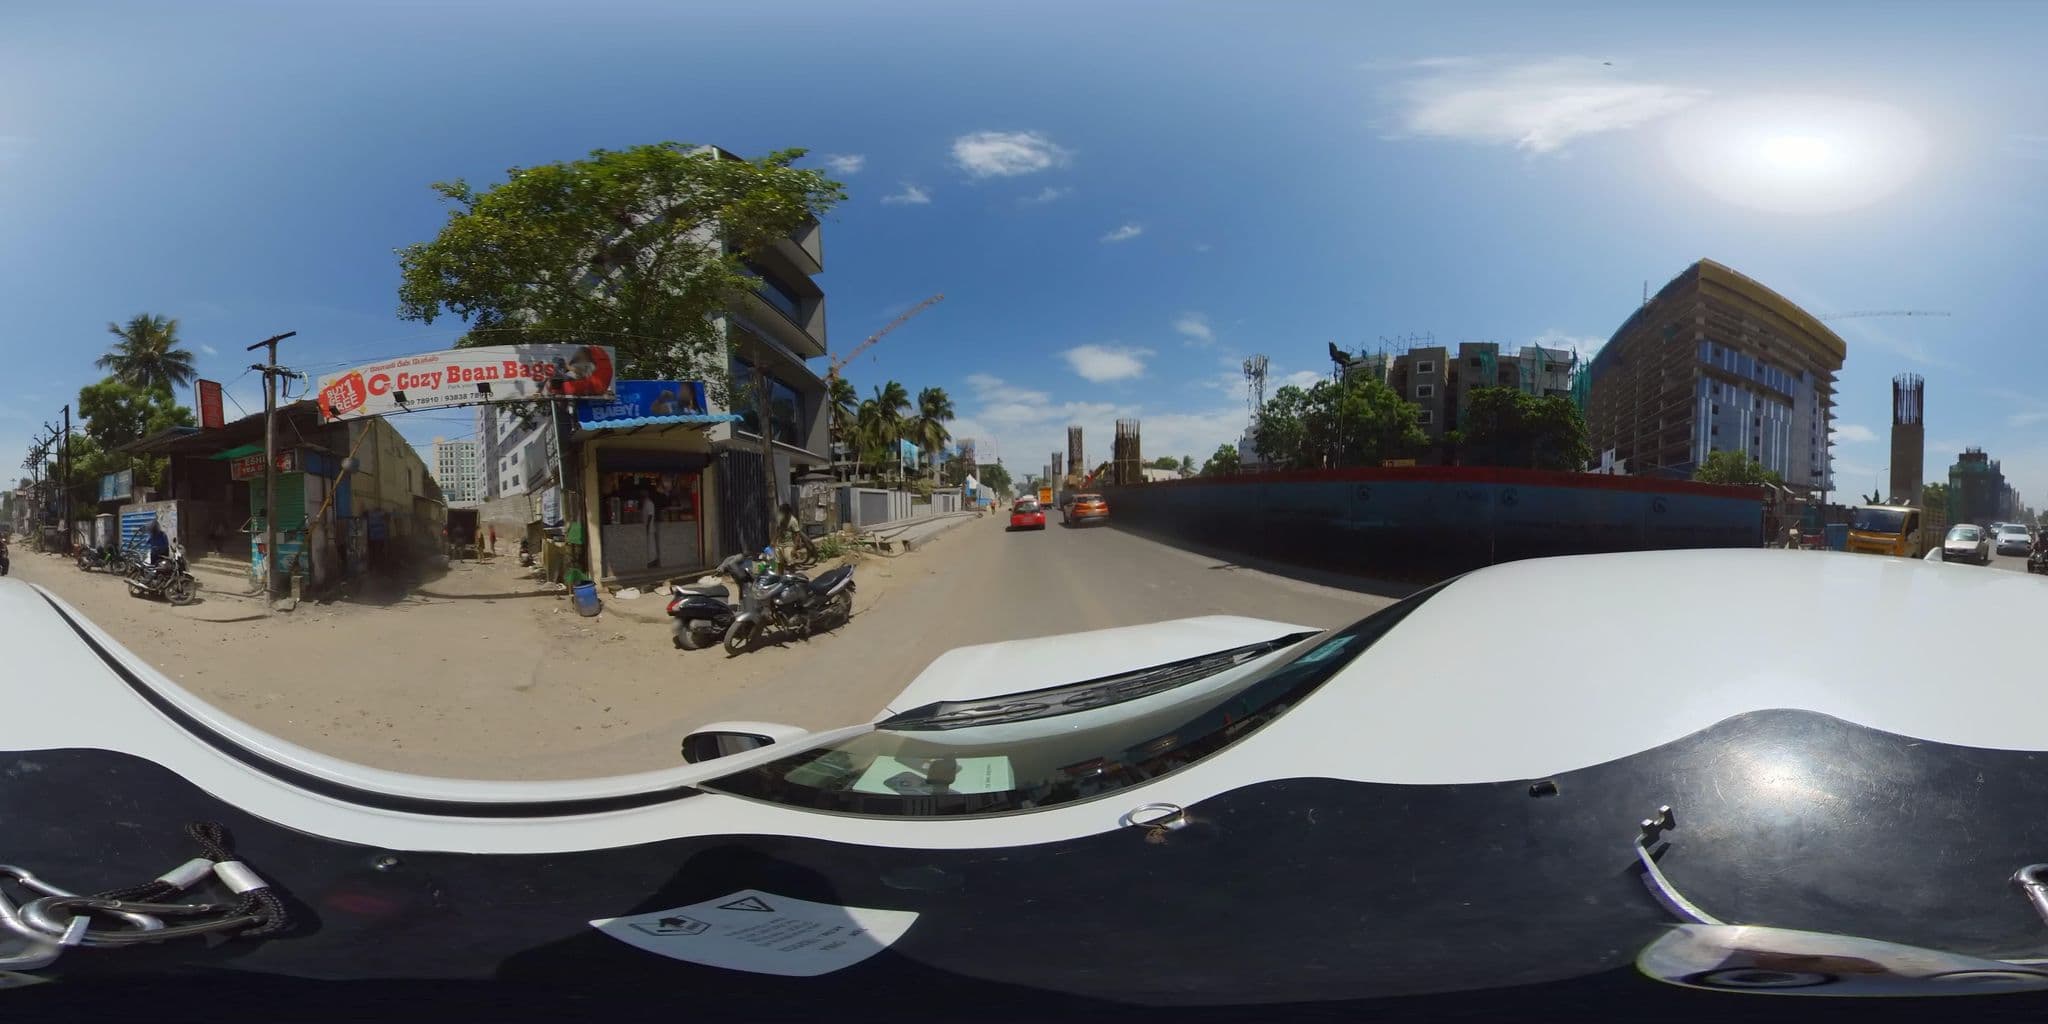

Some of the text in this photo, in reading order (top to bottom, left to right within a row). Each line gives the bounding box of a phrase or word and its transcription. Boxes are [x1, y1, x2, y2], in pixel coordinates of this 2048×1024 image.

[397, 360, 555, 390] Cozy Bean Bags
[327, 384, 343, 398] BUY
